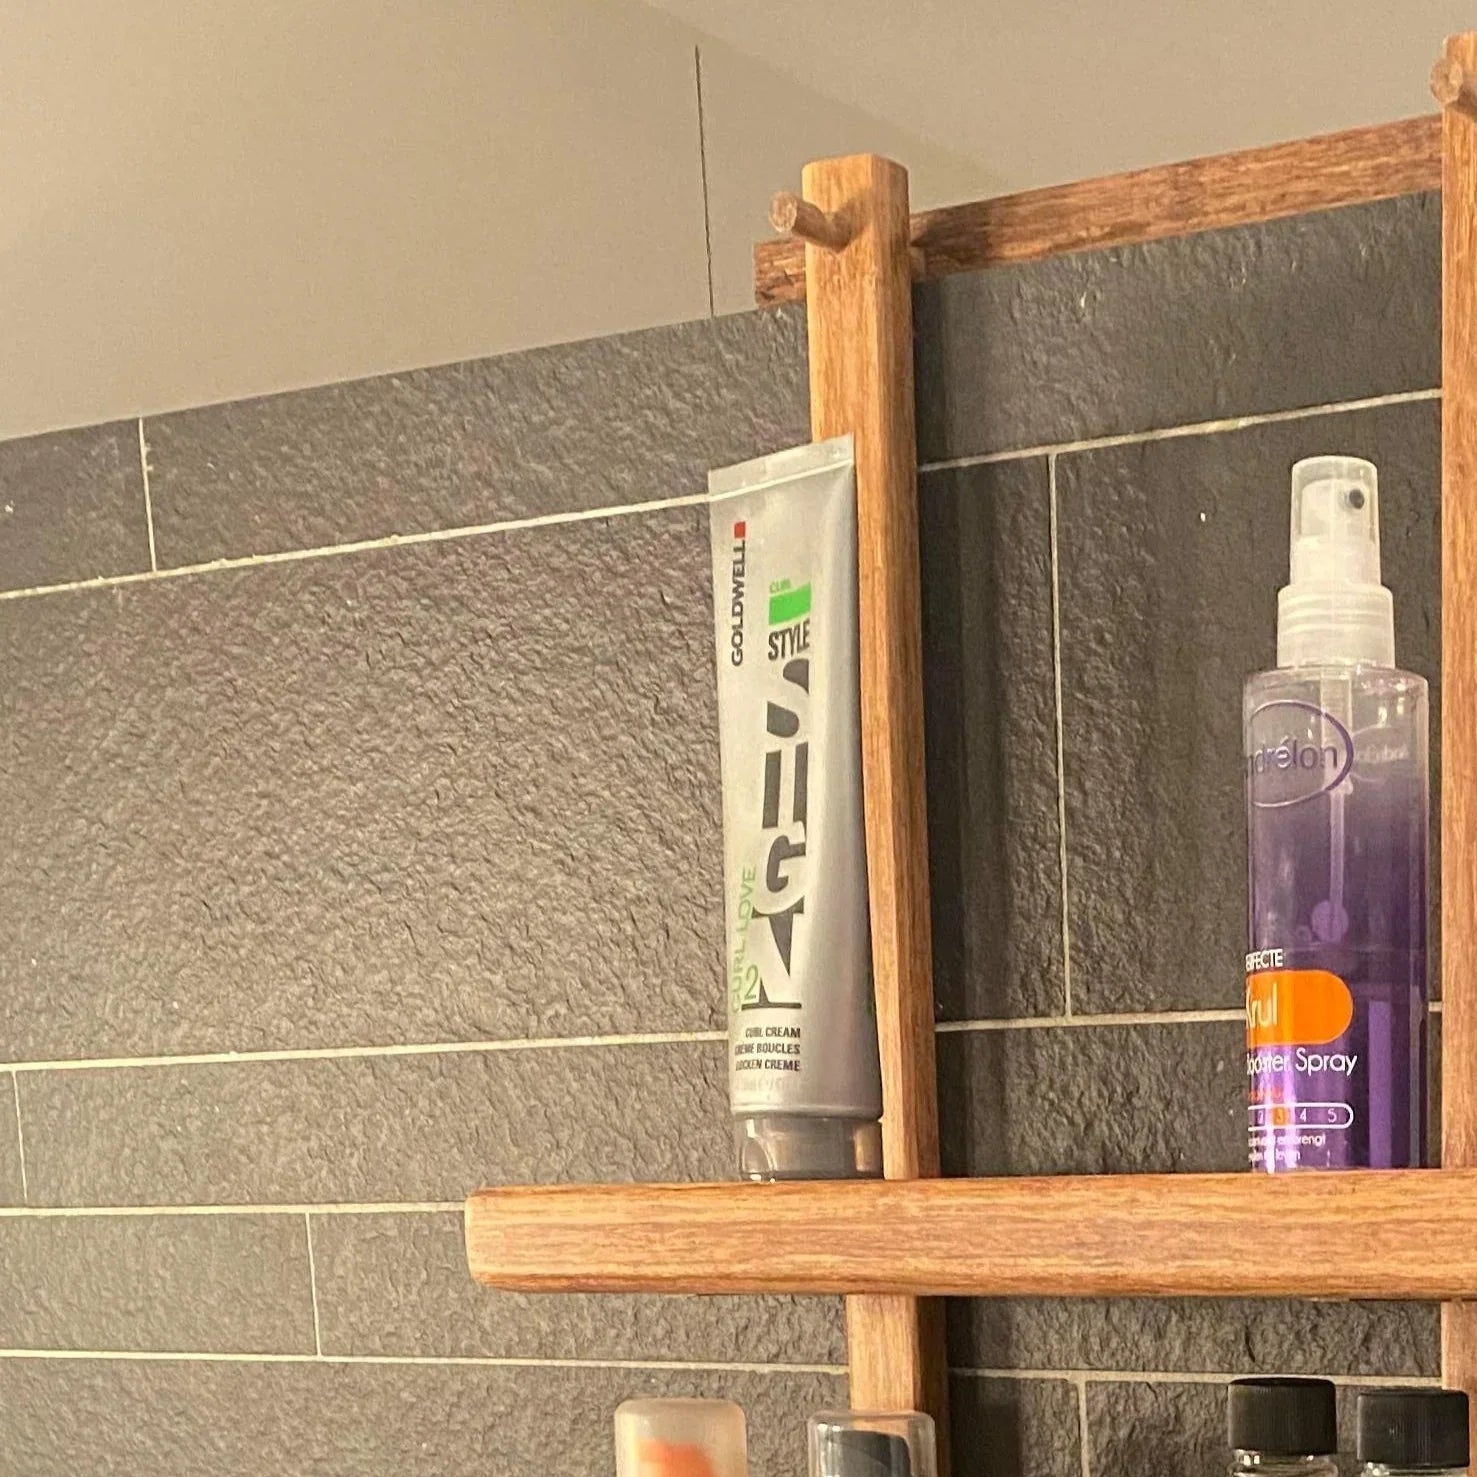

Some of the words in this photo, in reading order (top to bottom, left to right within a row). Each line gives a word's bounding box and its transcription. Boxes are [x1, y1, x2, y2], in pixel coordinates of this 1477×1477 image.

[732, 540, 746, 667] GOLDWELL
[767, 617, 811, 661] STYLE
[736, 865, 757, 932] LOVE
[744, 963, 759, 1000] 2
[765, 1026, 801, 1039] CREAM
[756, 1042, 801, 1055] BOUCLES
[1295, 1046, 1358, 1077] Spray
[764, 1059, 801, 1072] CREME
[1299, 1107, 1308, 1122] 4
[1327, 1107, 1337, 1123] 5
